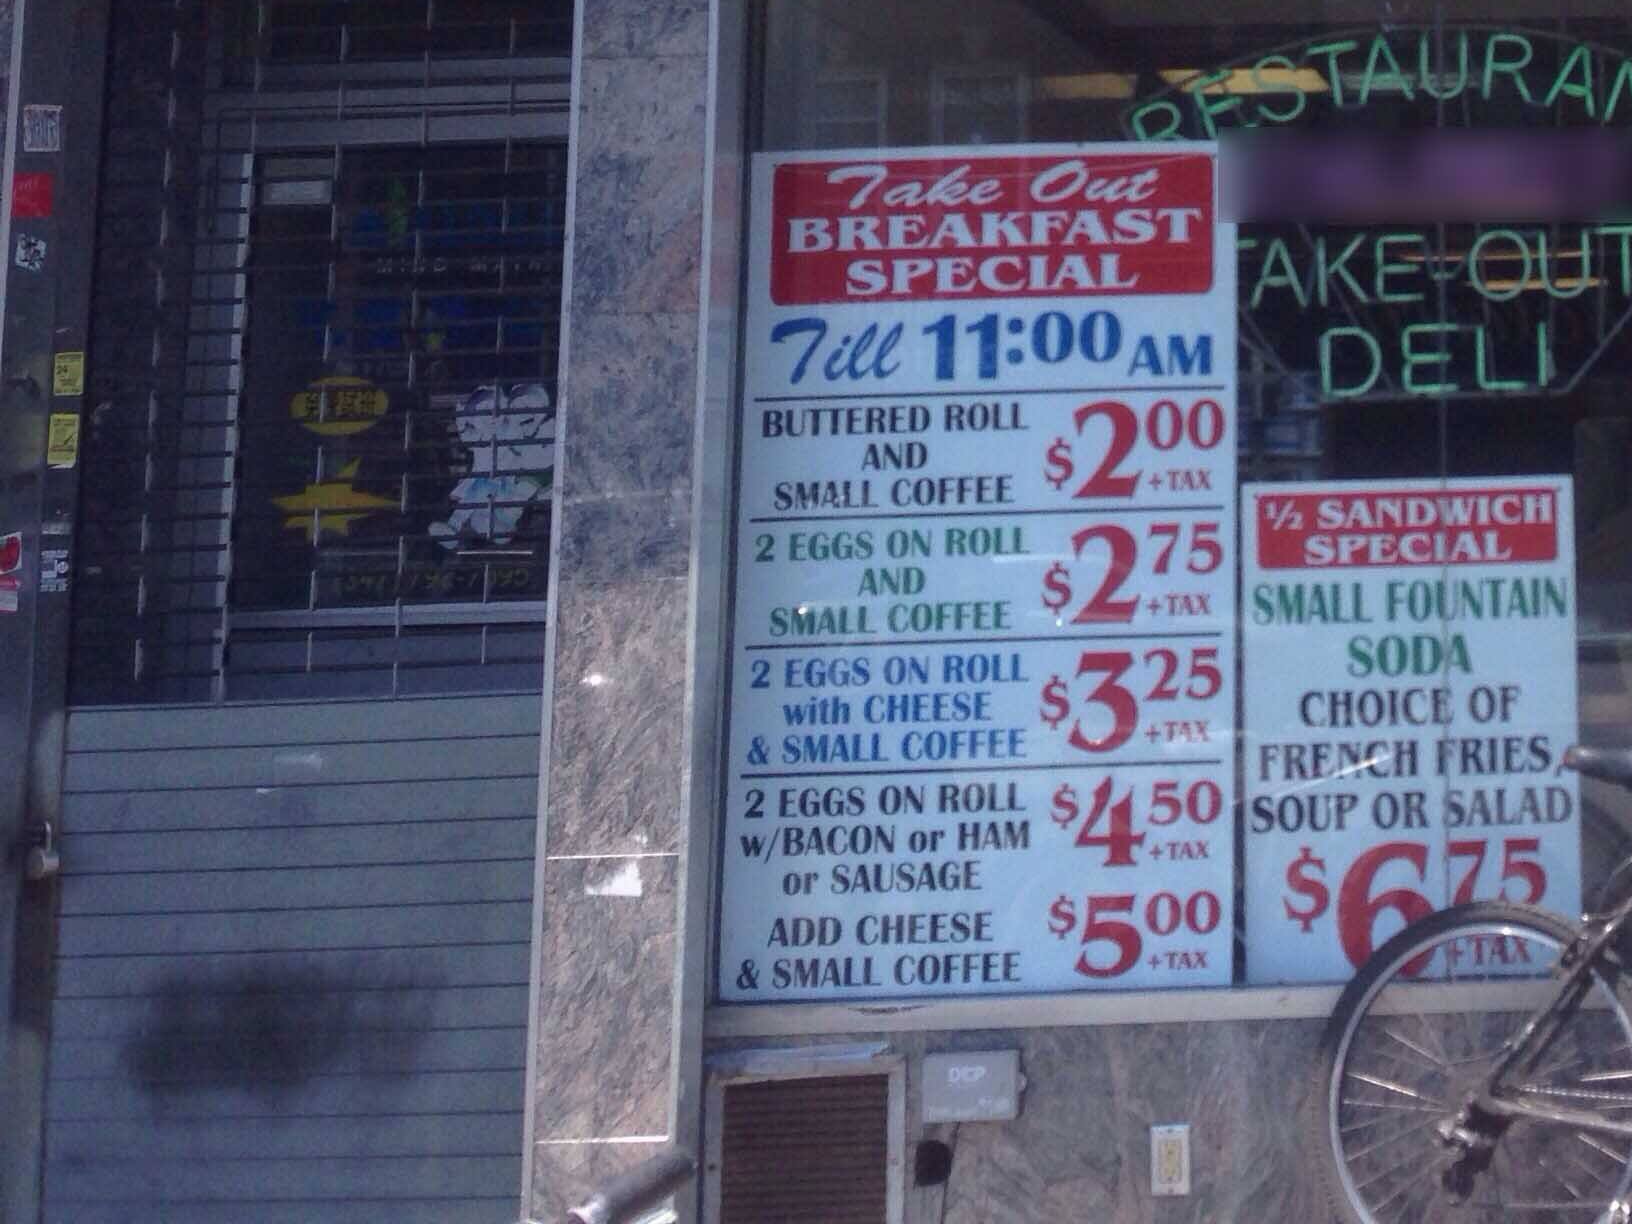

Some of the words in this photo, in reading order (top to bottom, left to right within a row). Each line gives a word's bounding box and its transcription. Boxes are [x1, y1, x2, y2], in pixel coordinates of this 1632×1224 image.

[827, 161, 1003, 211] Take
[1030, 158, 1160, 204] Out
[787, 207, 1201, 253] BREAKFAST
[845, 254, 1140, 295] SPECIAL
[769, 317, 905, 386] Till
[922, 311, 1122, 381] 11:00
[1128, 334, 1213, 377] AM
[1319, 321, 1549, 398] DELI
[762, 406, 931, 438] BUTTERED
[944, 403, 1030, 432] ROLL
[861, 442, 927, 472] AND
[773, 480, 879, 511] SMALL
[891, 476, 1014, 507] COFFEE
[1317, 493, 1554, 530] SANDWICH
[754, 534, 776, 562] 2
[787, 529, 873, 561] EGGS
[887, 528, 932, 558] ON
[945, 526, 1029, 556] ROLL
[1303, 531, 1513, 566] SPECIAL
[857, 567, 926, 596] AND
[769, 605, 877, 637] SMALL
[887, 601, 1012, 633] COFFEE
[1253, 581, 1373, 626] SMALL
[1385, 577, 1568, 622] FOUNTAIN
[751, 660, 771, 688] 2
[785, 655, 871, 688] EGGS
[884, 655, 931, 686] ON
[942, 652, 1029, 682] ROLL
[1347, 634, 1474, 677] SODA
[783, 696, 850, 725] with
[863, 691, 992, 723] CHEESE
[1300, 687, 1454, 728] CHOICE
[1469, 685, 1522, 723] OF
[747, 735, 769, 765] &
[782, 732, 888, 764] SMALL
[902, 729, 1027, 760] COFFEE
[1259, 740, 1419, 782] FRENCH
[744, 789, 764, 818] 2
[778, 785, 865, 817] EGGS
[878, 784, 925, 815] ON
[938, 782, 1026, 811] ROLL
[1251, 793, 1358, 834] SOUP
[1373, 791, 1430, 830] OR
[1443, 786, 1573, 828] SALAD
[741, 824, 896, 862] w/BACON
[908, 828, 945, 853] or
[957, 820, 1030, 851] HAM
[782, 870, 819, 895] or
[830, 860, 983, 893] SAUSAGE
[767, 916, 842, 947] ADD
[855, 912, 994, 945] CHEESE
[736, 961, 760, 990] &
[772, 957, 880, 989] SMALL
[893, 952, 1022, 985] COFFEE
